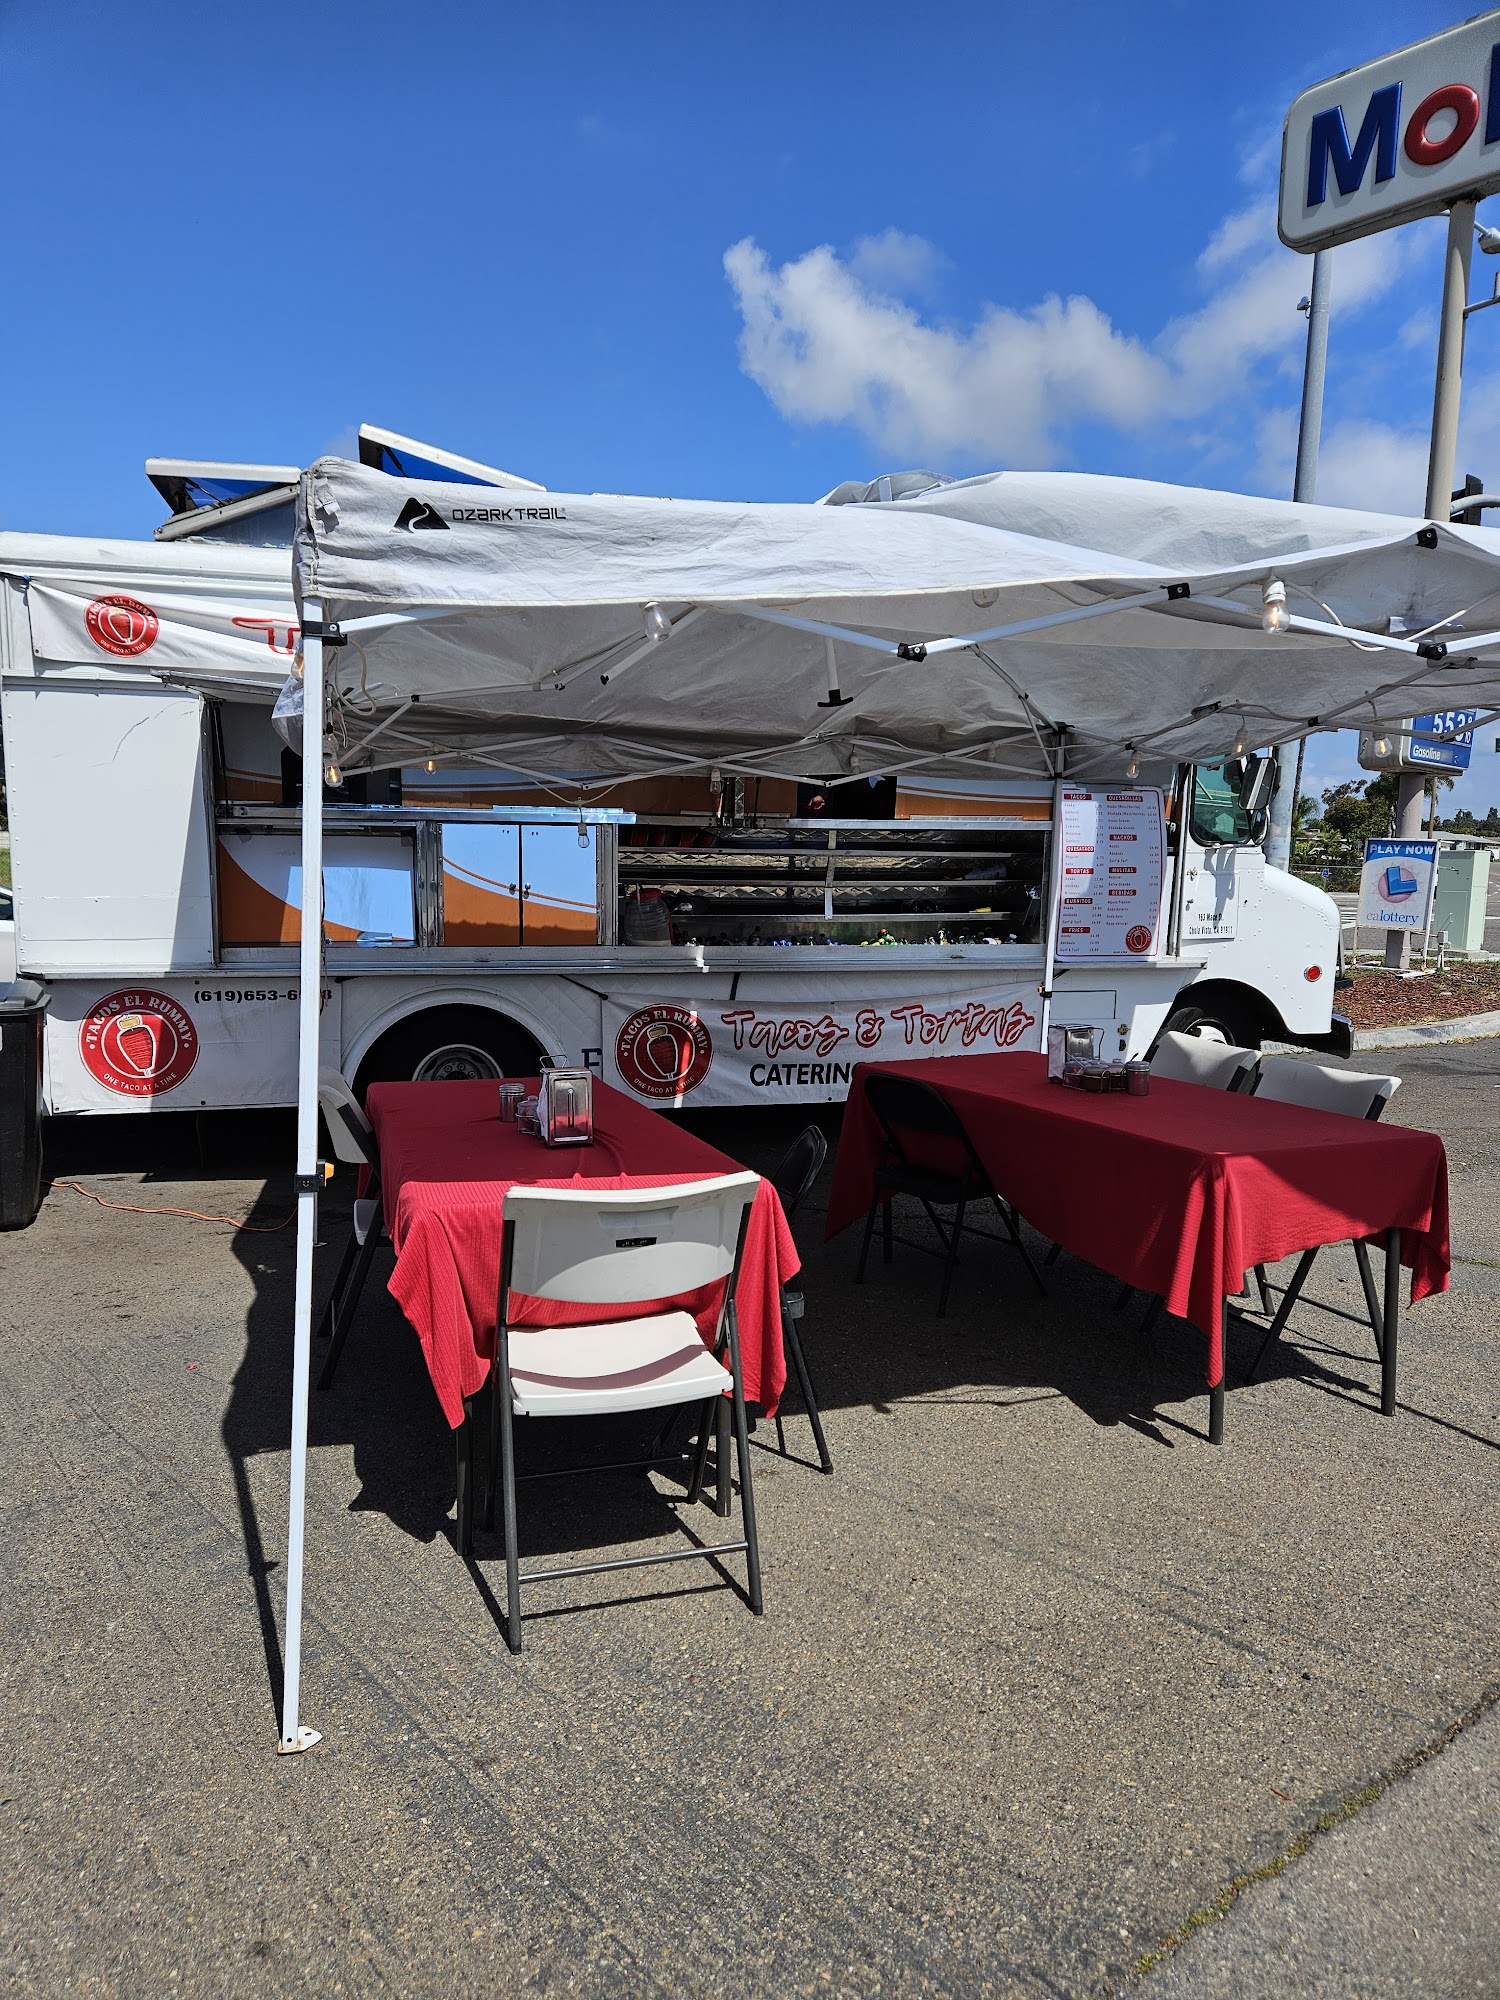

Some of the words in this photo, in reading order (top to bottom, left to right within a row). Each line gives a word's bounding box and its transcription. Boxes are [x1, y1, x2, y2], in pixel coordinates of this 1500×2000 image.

[1307, 43, 1500, 207] Mo
[452, 508, 513, 521] OZARK
[514, 507, 566, 520] TRAIL
[1412, 744, 1441, 761] Gasoline
[1369, 844, 1402, 854] PLAY
[1405, 845, 1435, 855] NOW
[85, 1000, 120, 1043] TACOS
[123, 995, 144, 1007] EL
[148, 996, 193, 1041] RUMMY
[621, 1013, 651, 1051] TACOS
[653, 1010, 670, 1020] EL
[673, 1011, 708, 1048] RUMMY
[720, 1010, 850, 1058] Tacos
[855, 1008, 885, 1048] &
[891, 1001, 1035, 1047] Tortas
[103, 1073, 119, 1086] ONE
[120, 1081, 140, 1091] TACO
[160, 1072, 177, 1086] TIME
[633, 1078, 647, 1089] ONE
[647, 1085, 664, 1094] TACO
[680, 1076, 695, 1089] TIME
